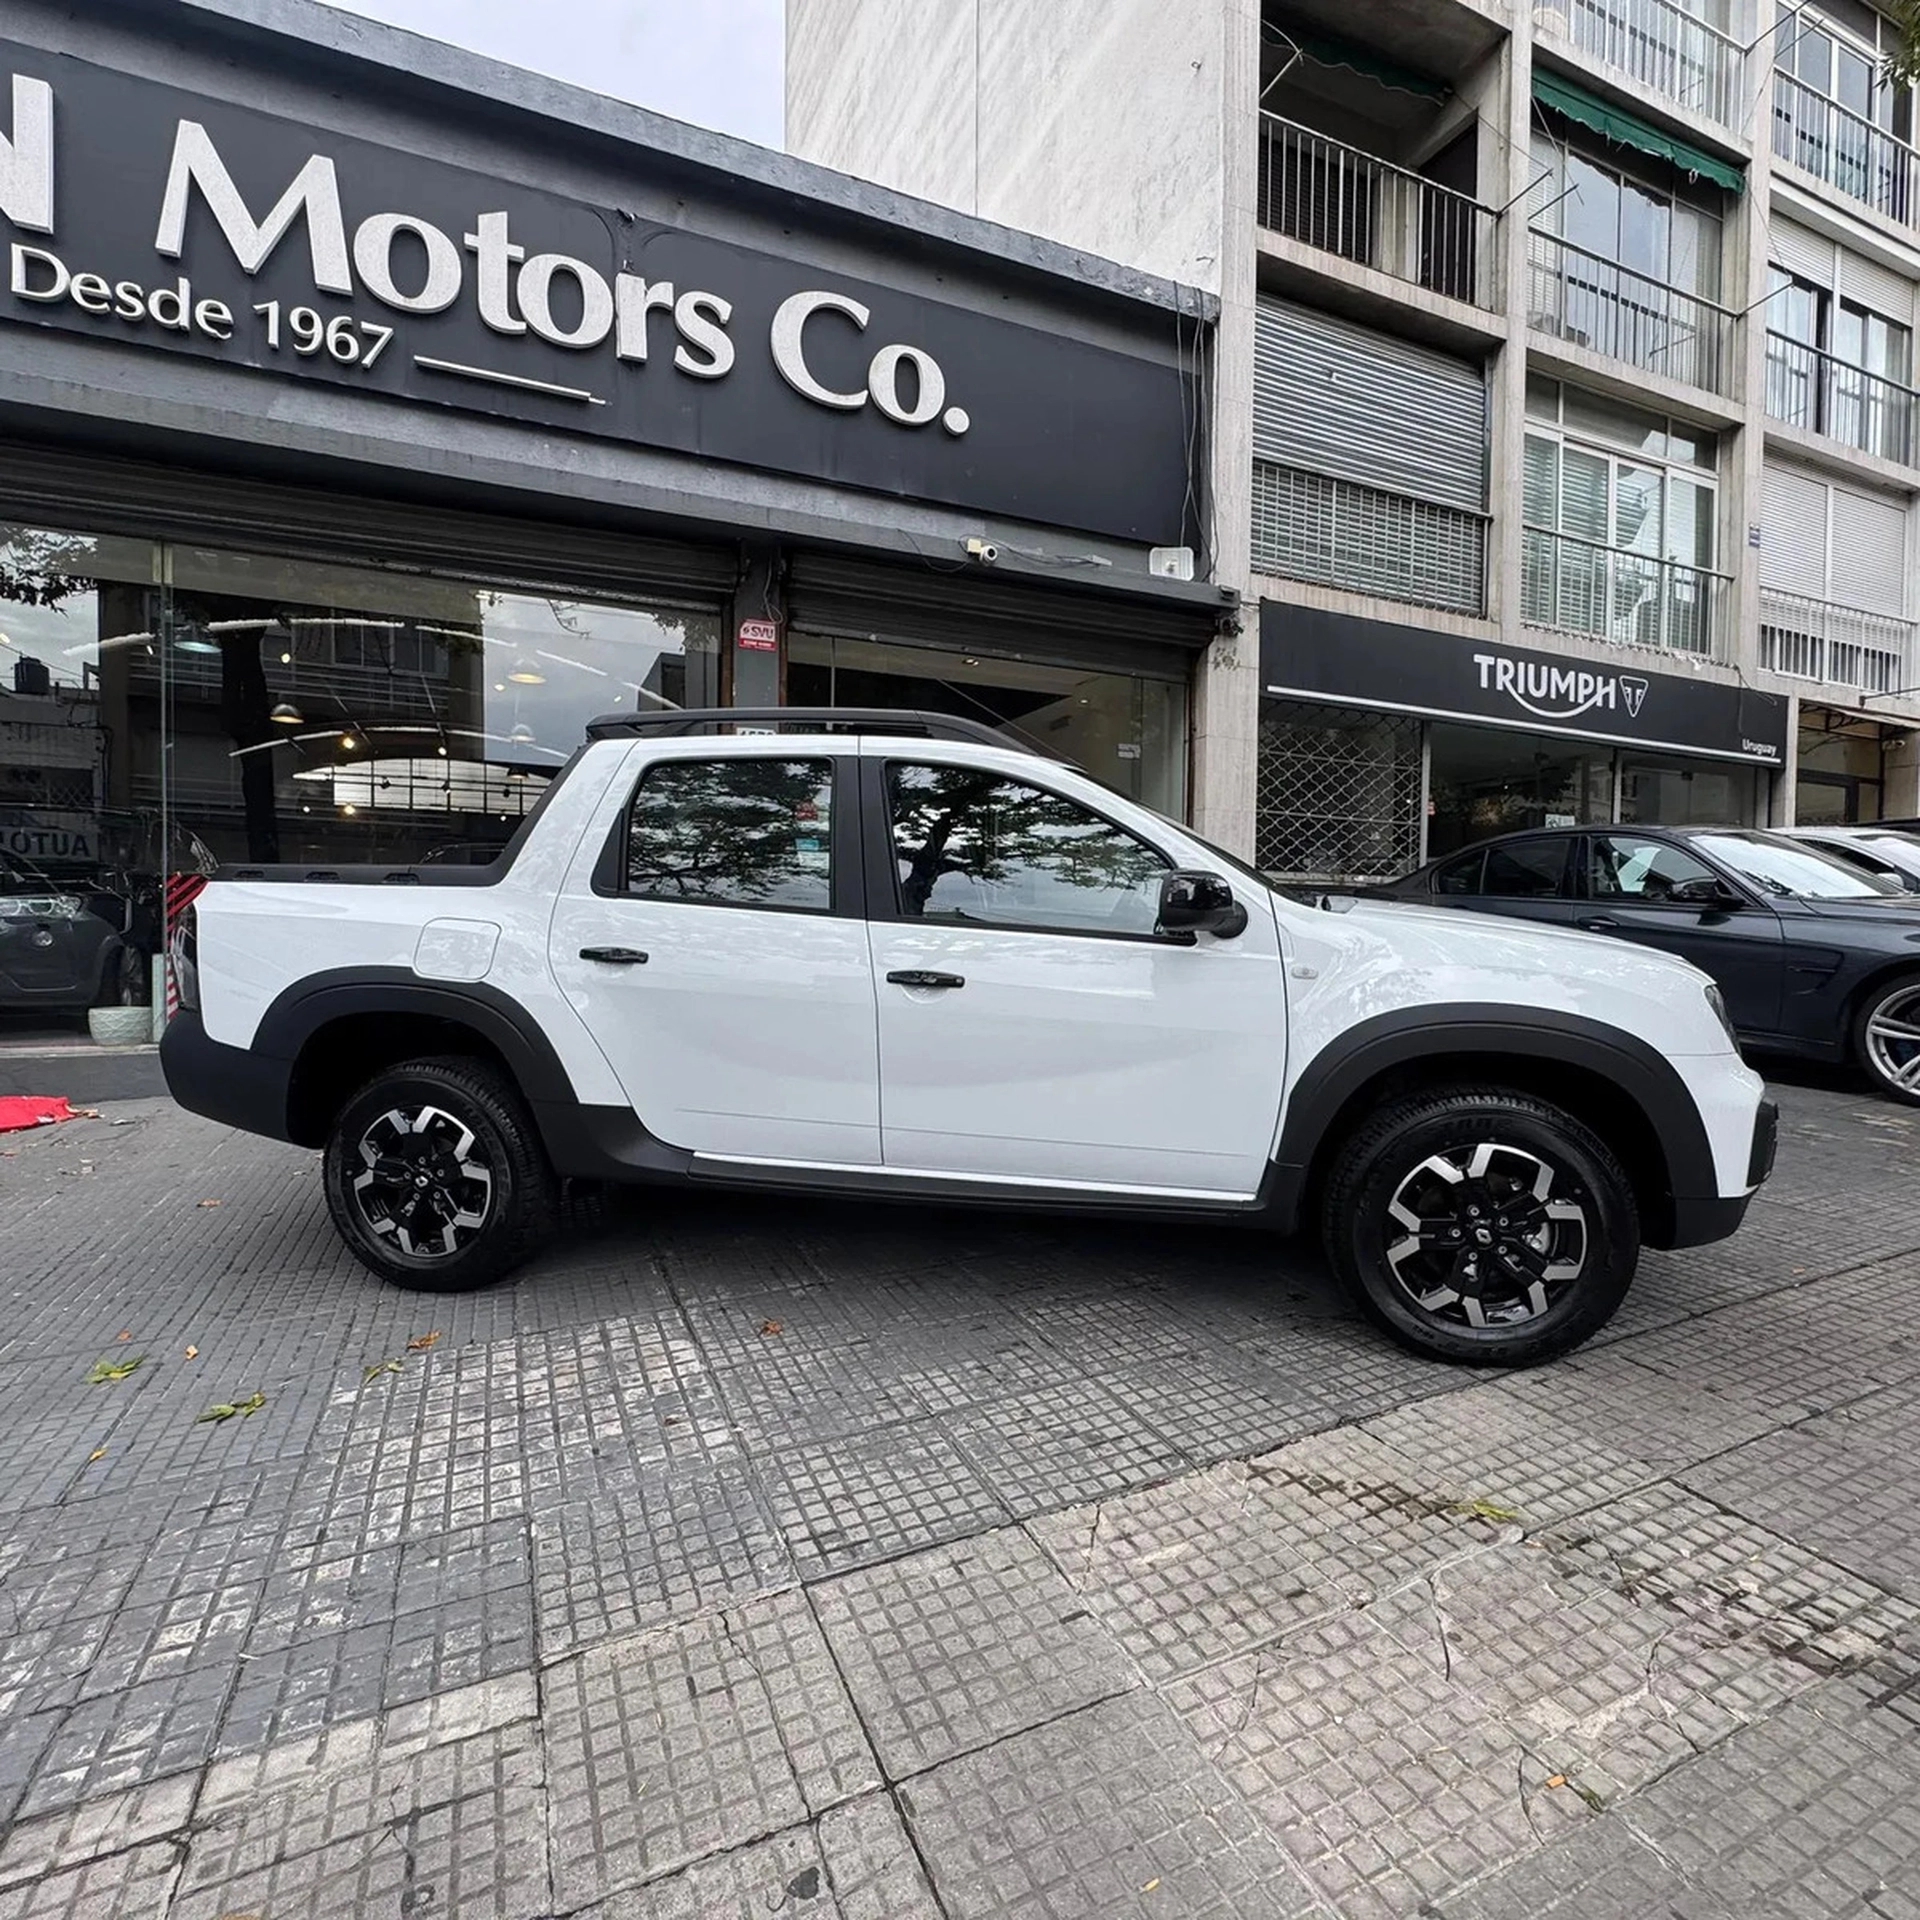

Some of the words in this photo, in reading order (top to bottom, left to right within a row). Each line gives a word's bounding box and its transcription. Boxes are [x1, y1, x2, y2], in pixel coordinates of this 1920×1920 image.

[10, 242, 235, 340] Desde
[252, 300, 395, 369] 1967
[155, 118, 736, 379] Motors
[770, 290, 971, 436] Co.
[1473, 653, 1616, 718] TRIUMPH
[1742, 738, 1777, 757] Uruguay
